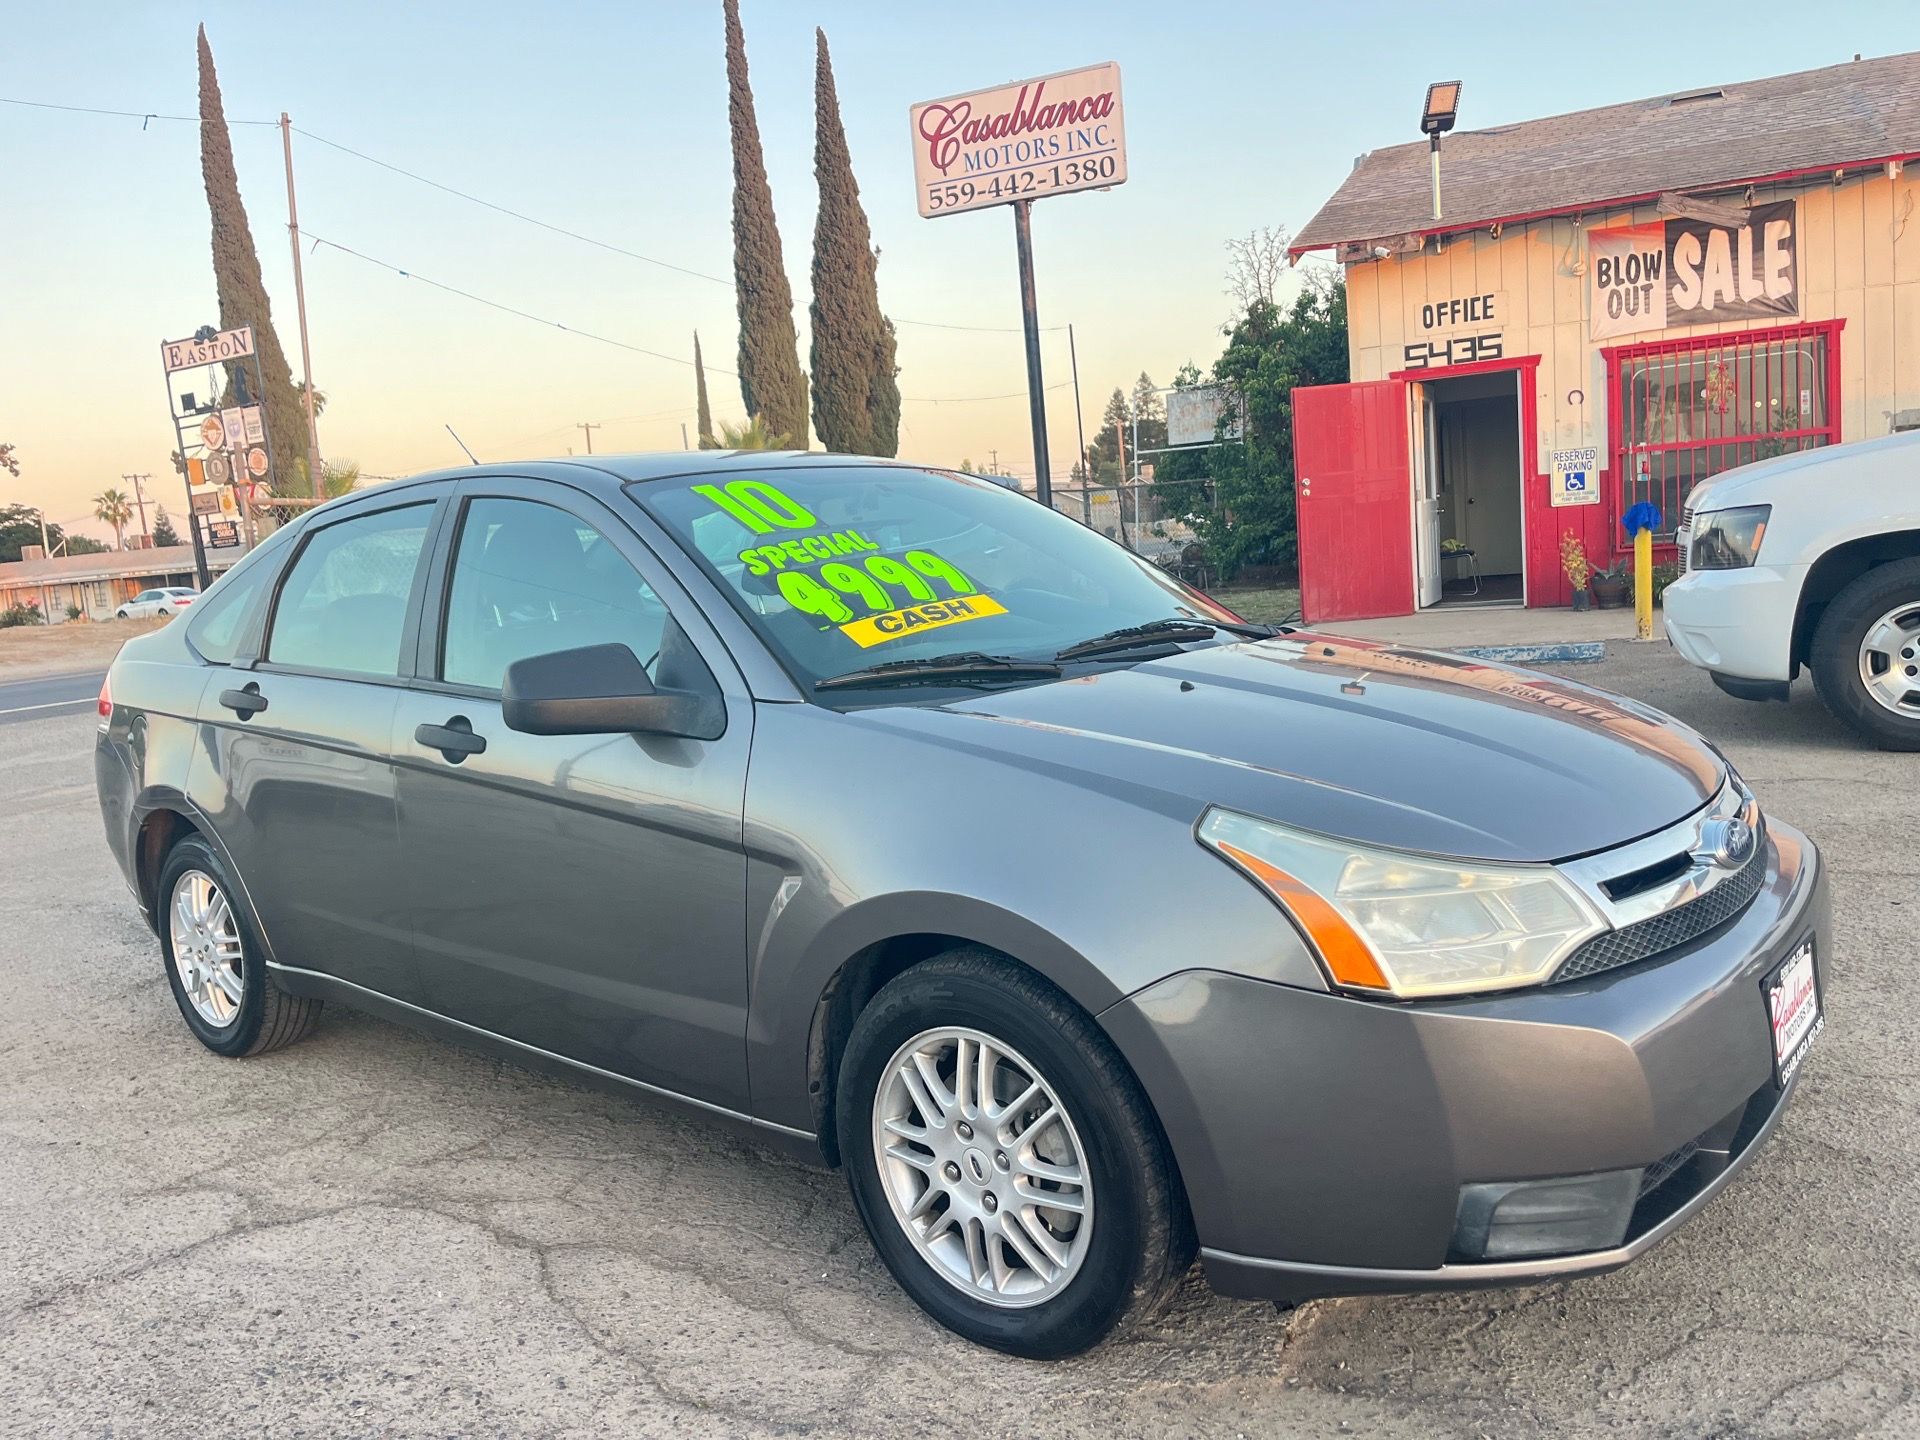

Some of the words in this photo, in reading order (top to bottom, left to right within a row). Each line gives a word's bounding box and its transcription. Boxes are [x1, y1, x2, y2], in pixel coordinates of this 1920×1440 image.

[919, 82, 1115, 176] Casablanca
[963, 134, 1060, 173] MOTORS
[1067, 124, 1115, 152] INC.
[929, 155, 1116, 210] 559-442-1380
[1597, 249, 1663, 290] BLOW
[1671, 219, 1793, 311] SALE
[1422, 294, 1495, 330] OFFICE
[1607, 283, 1654, 320] OUT
[1404, 333, 1503, 370] 5435
[1553, 449, 1596, 463] RESERVED
[1557, 460, 1593, 473] PARKING
[690, 480, 817, 535] 10
[737, 529, 881, 576] SPECIAL
[776, 549, 978, 623] 4999
[873, 599, 976, 634] CASH
